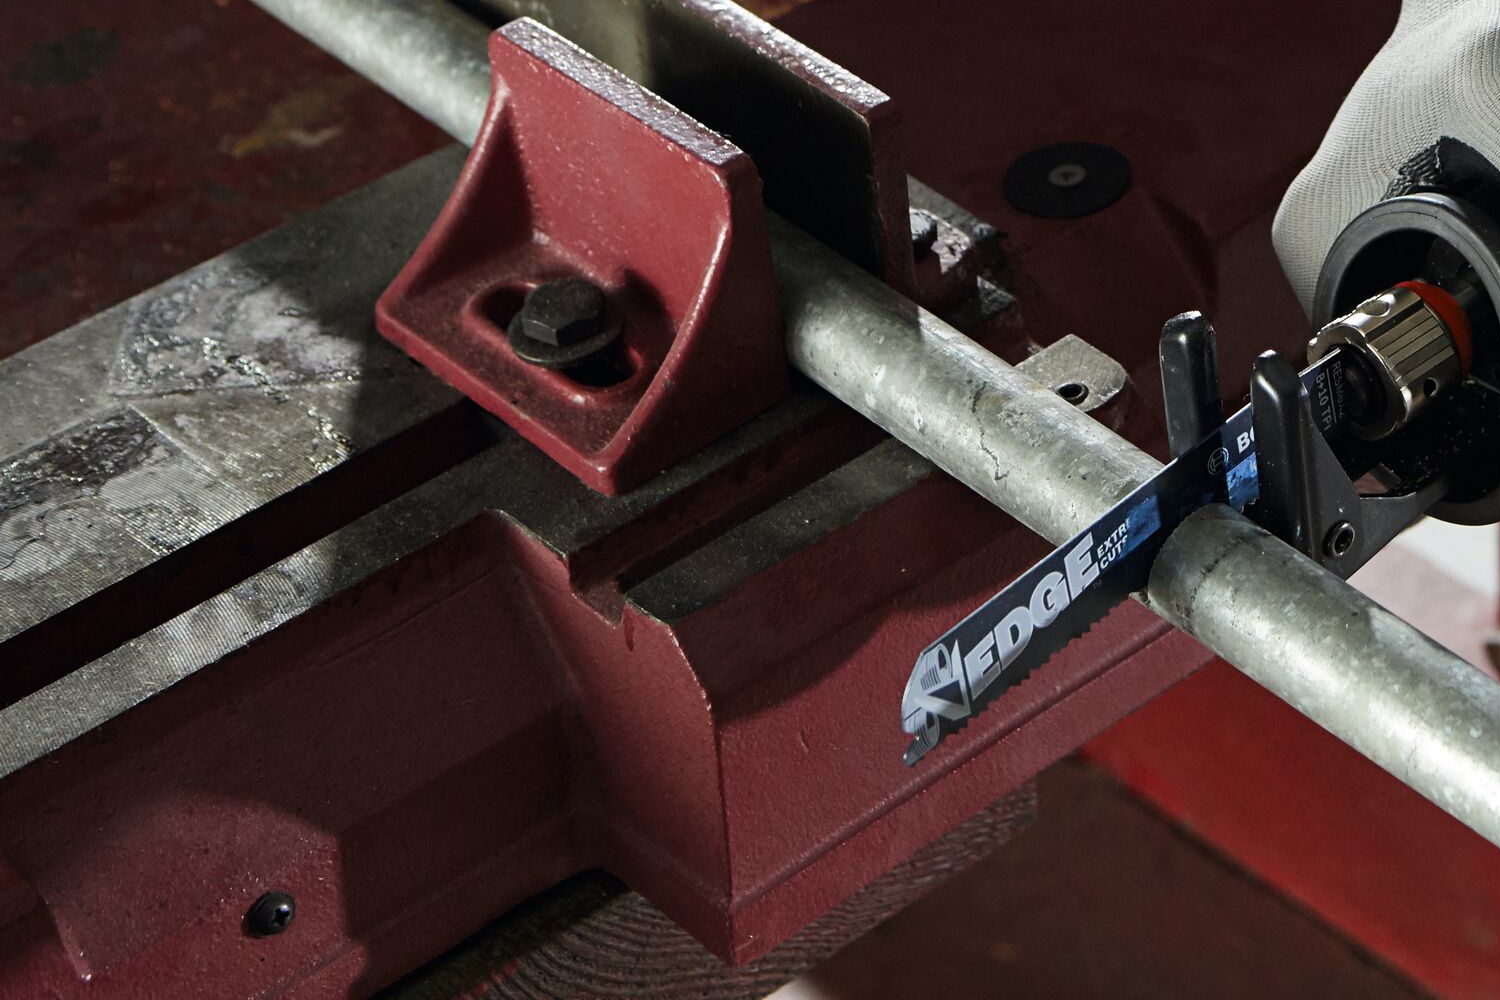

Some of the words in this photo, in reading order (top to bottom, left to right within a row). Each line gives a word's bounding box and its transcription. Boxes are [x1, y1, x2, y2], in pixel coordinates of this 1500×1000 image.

[1315, 372, 1329, 406] 8+10
[1321, 405, 1332, 431] TPI
[964, 531, 1100, 701] EDGE
